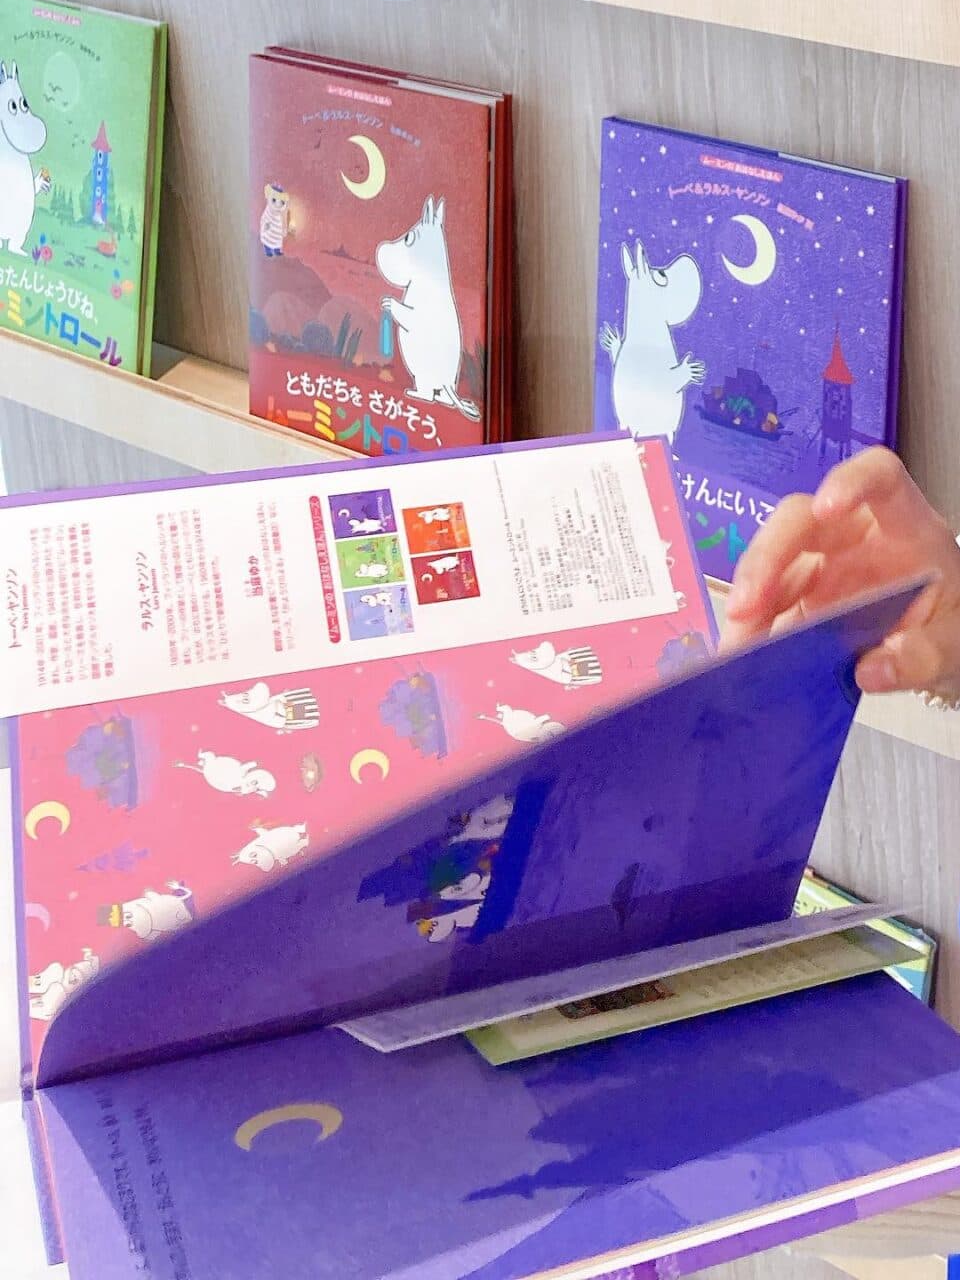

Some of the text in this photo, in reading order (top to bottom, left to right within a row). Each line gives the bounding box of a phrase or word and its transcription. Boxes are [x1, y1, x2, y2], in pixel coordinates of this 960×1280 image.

[286, 370, 443, 448] ともだちを さがそう、
[7, 568, 22, 649] トーベ・ヤンソン
[136, 551, 154, 631] ラルス・ヤンソン
